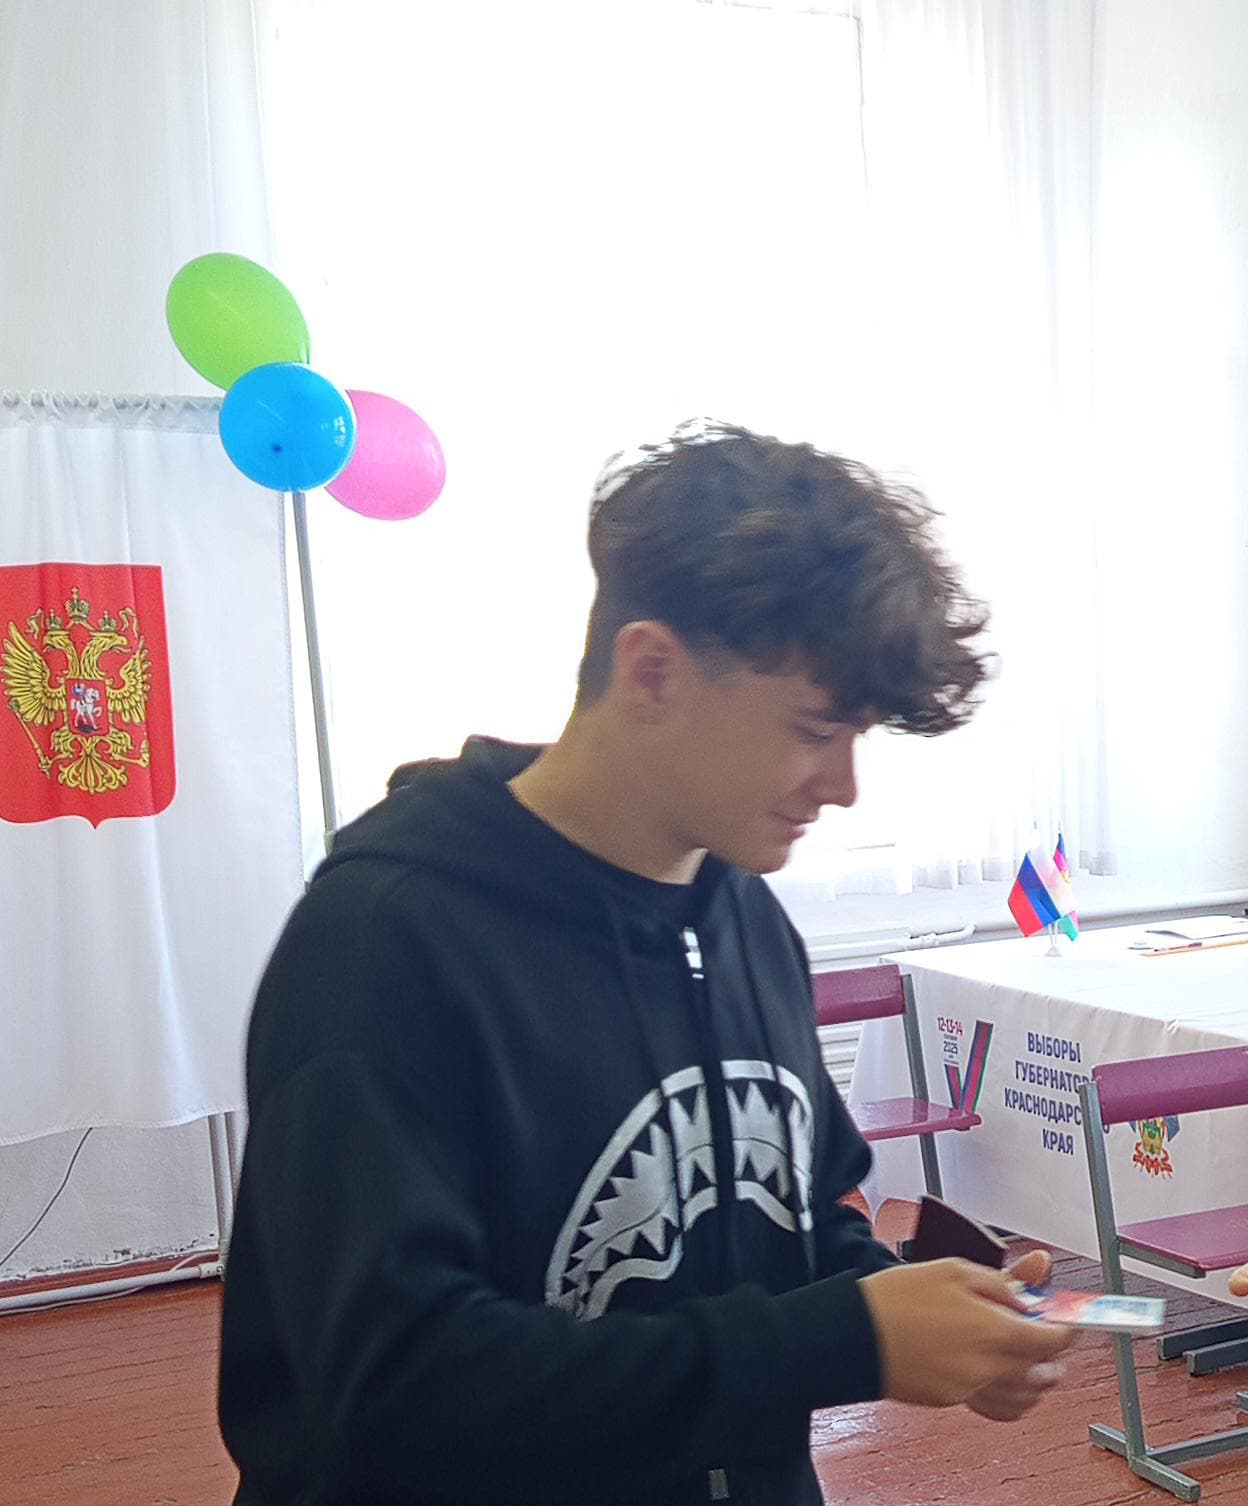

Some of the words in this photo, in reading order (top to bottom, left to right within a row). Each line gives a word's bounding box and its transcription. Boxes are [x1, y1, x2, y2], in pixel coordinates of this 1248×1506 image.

[1027, 1031, 1081, 1063] ВЫБОРЫ
[1015, 1060, 1095, 1095] ГУБЕРНАТО
[1042, 1128, 1074, 1155] КРАЯ
